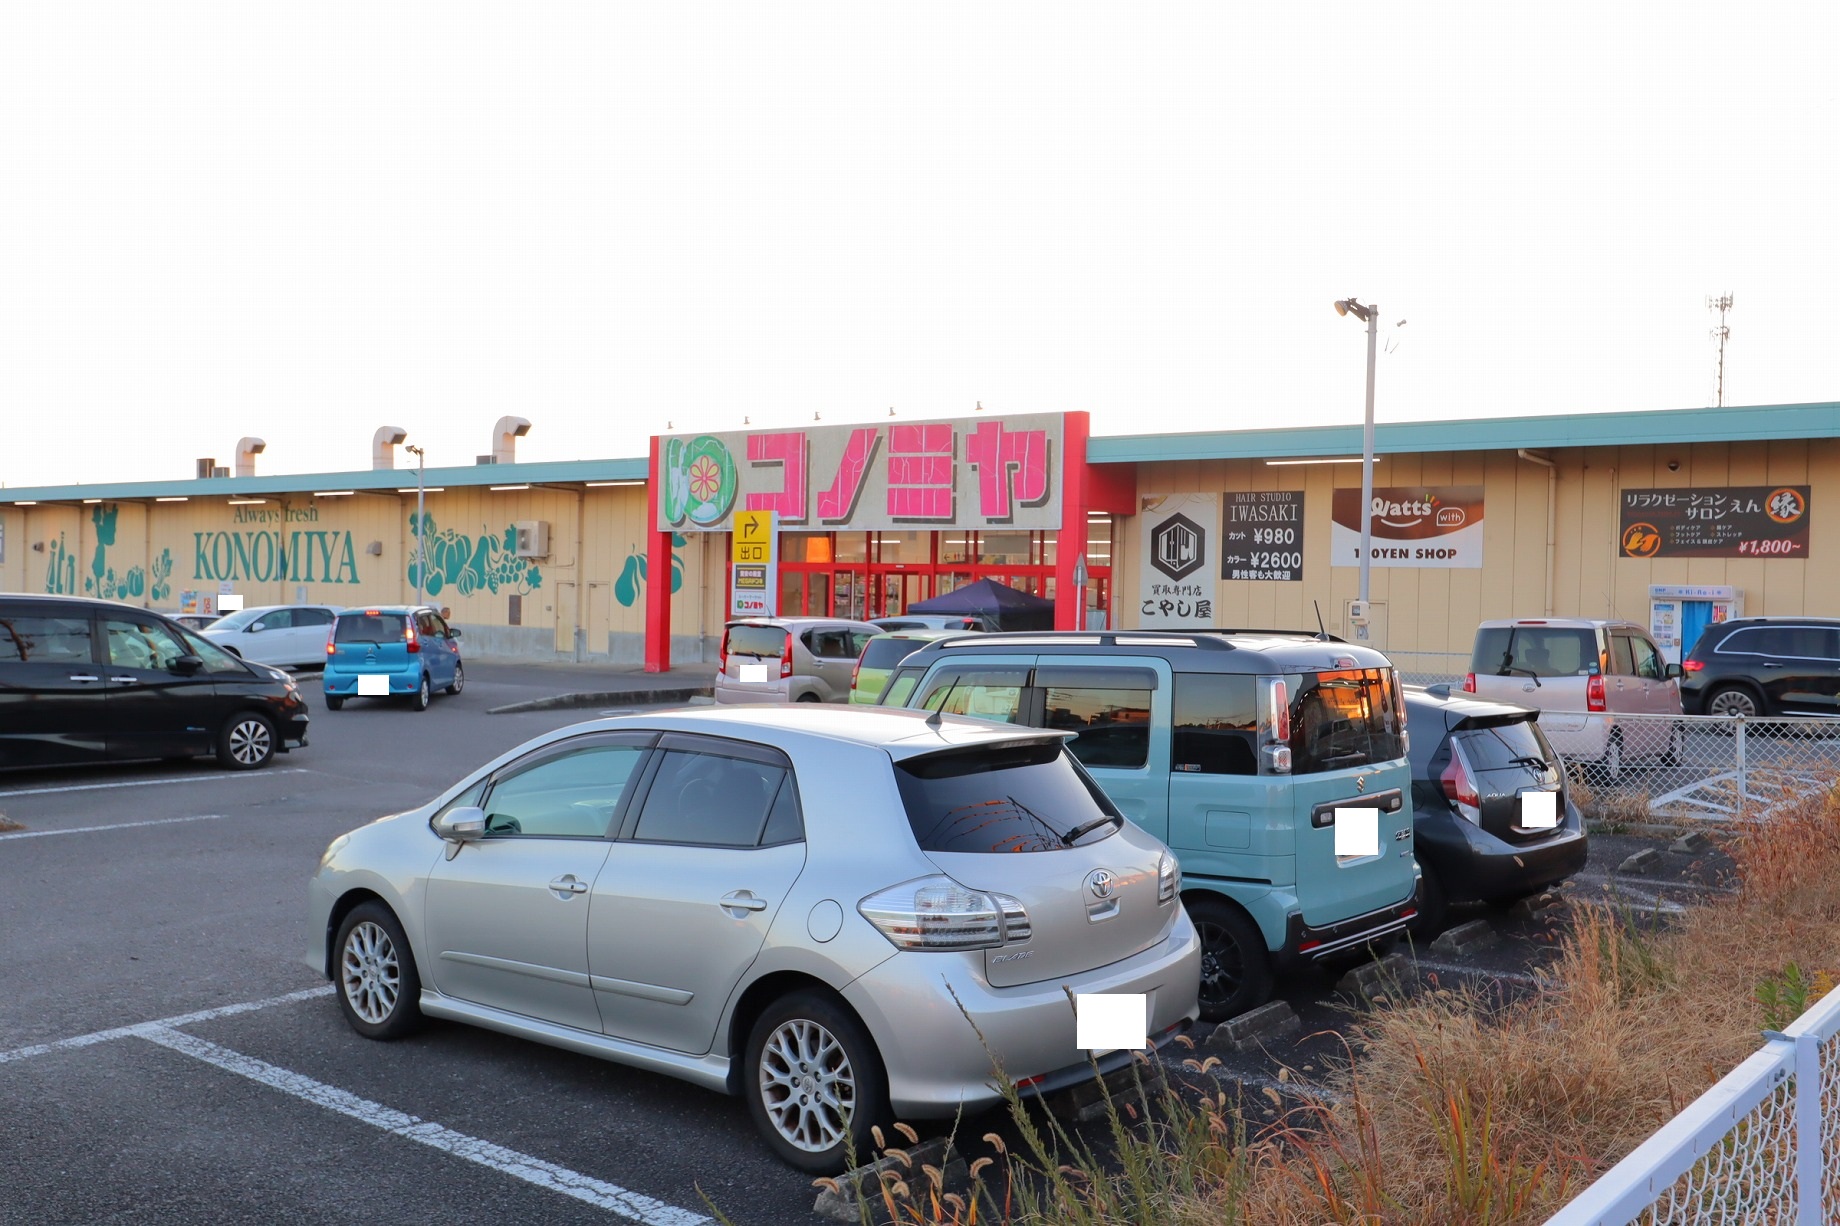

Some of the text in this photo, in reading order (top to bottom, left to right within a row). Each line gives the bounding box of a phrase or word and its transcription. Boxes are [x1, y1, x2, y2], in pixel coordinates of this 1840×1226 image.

[1235, 492, 1292, 503] HAIR STUDIO
[1627, 493, 1727, 507] リラクゼーション
[1371, 497, 1432, 517] Watts
[1730, 499, 1762, 513] えん
[1770, 492, 1801, 519] 縁
[234, 503, 319, 527] Always fresh
[1230, 504, 1298, 522] IWASAKI
[1440, 512, 1461, 522] with
[1685, 507, 1727, 520] サロン
[1229, 528, 1295, 545] カット ¥980
[193, 530, 361, 584] KONOMIYA
[740, 546, 762, 560] 出口
[1227, 552, 1301, 568] カラー ¥2600
[1354, 548, 1457, 559] 10YEN SHOP
[1232, 570, 1291, 580] 男性客も大歓迎
[1151, 584, 1202, 597] 買取専門店
[1141, 599, 1212, 619] こやし屋
